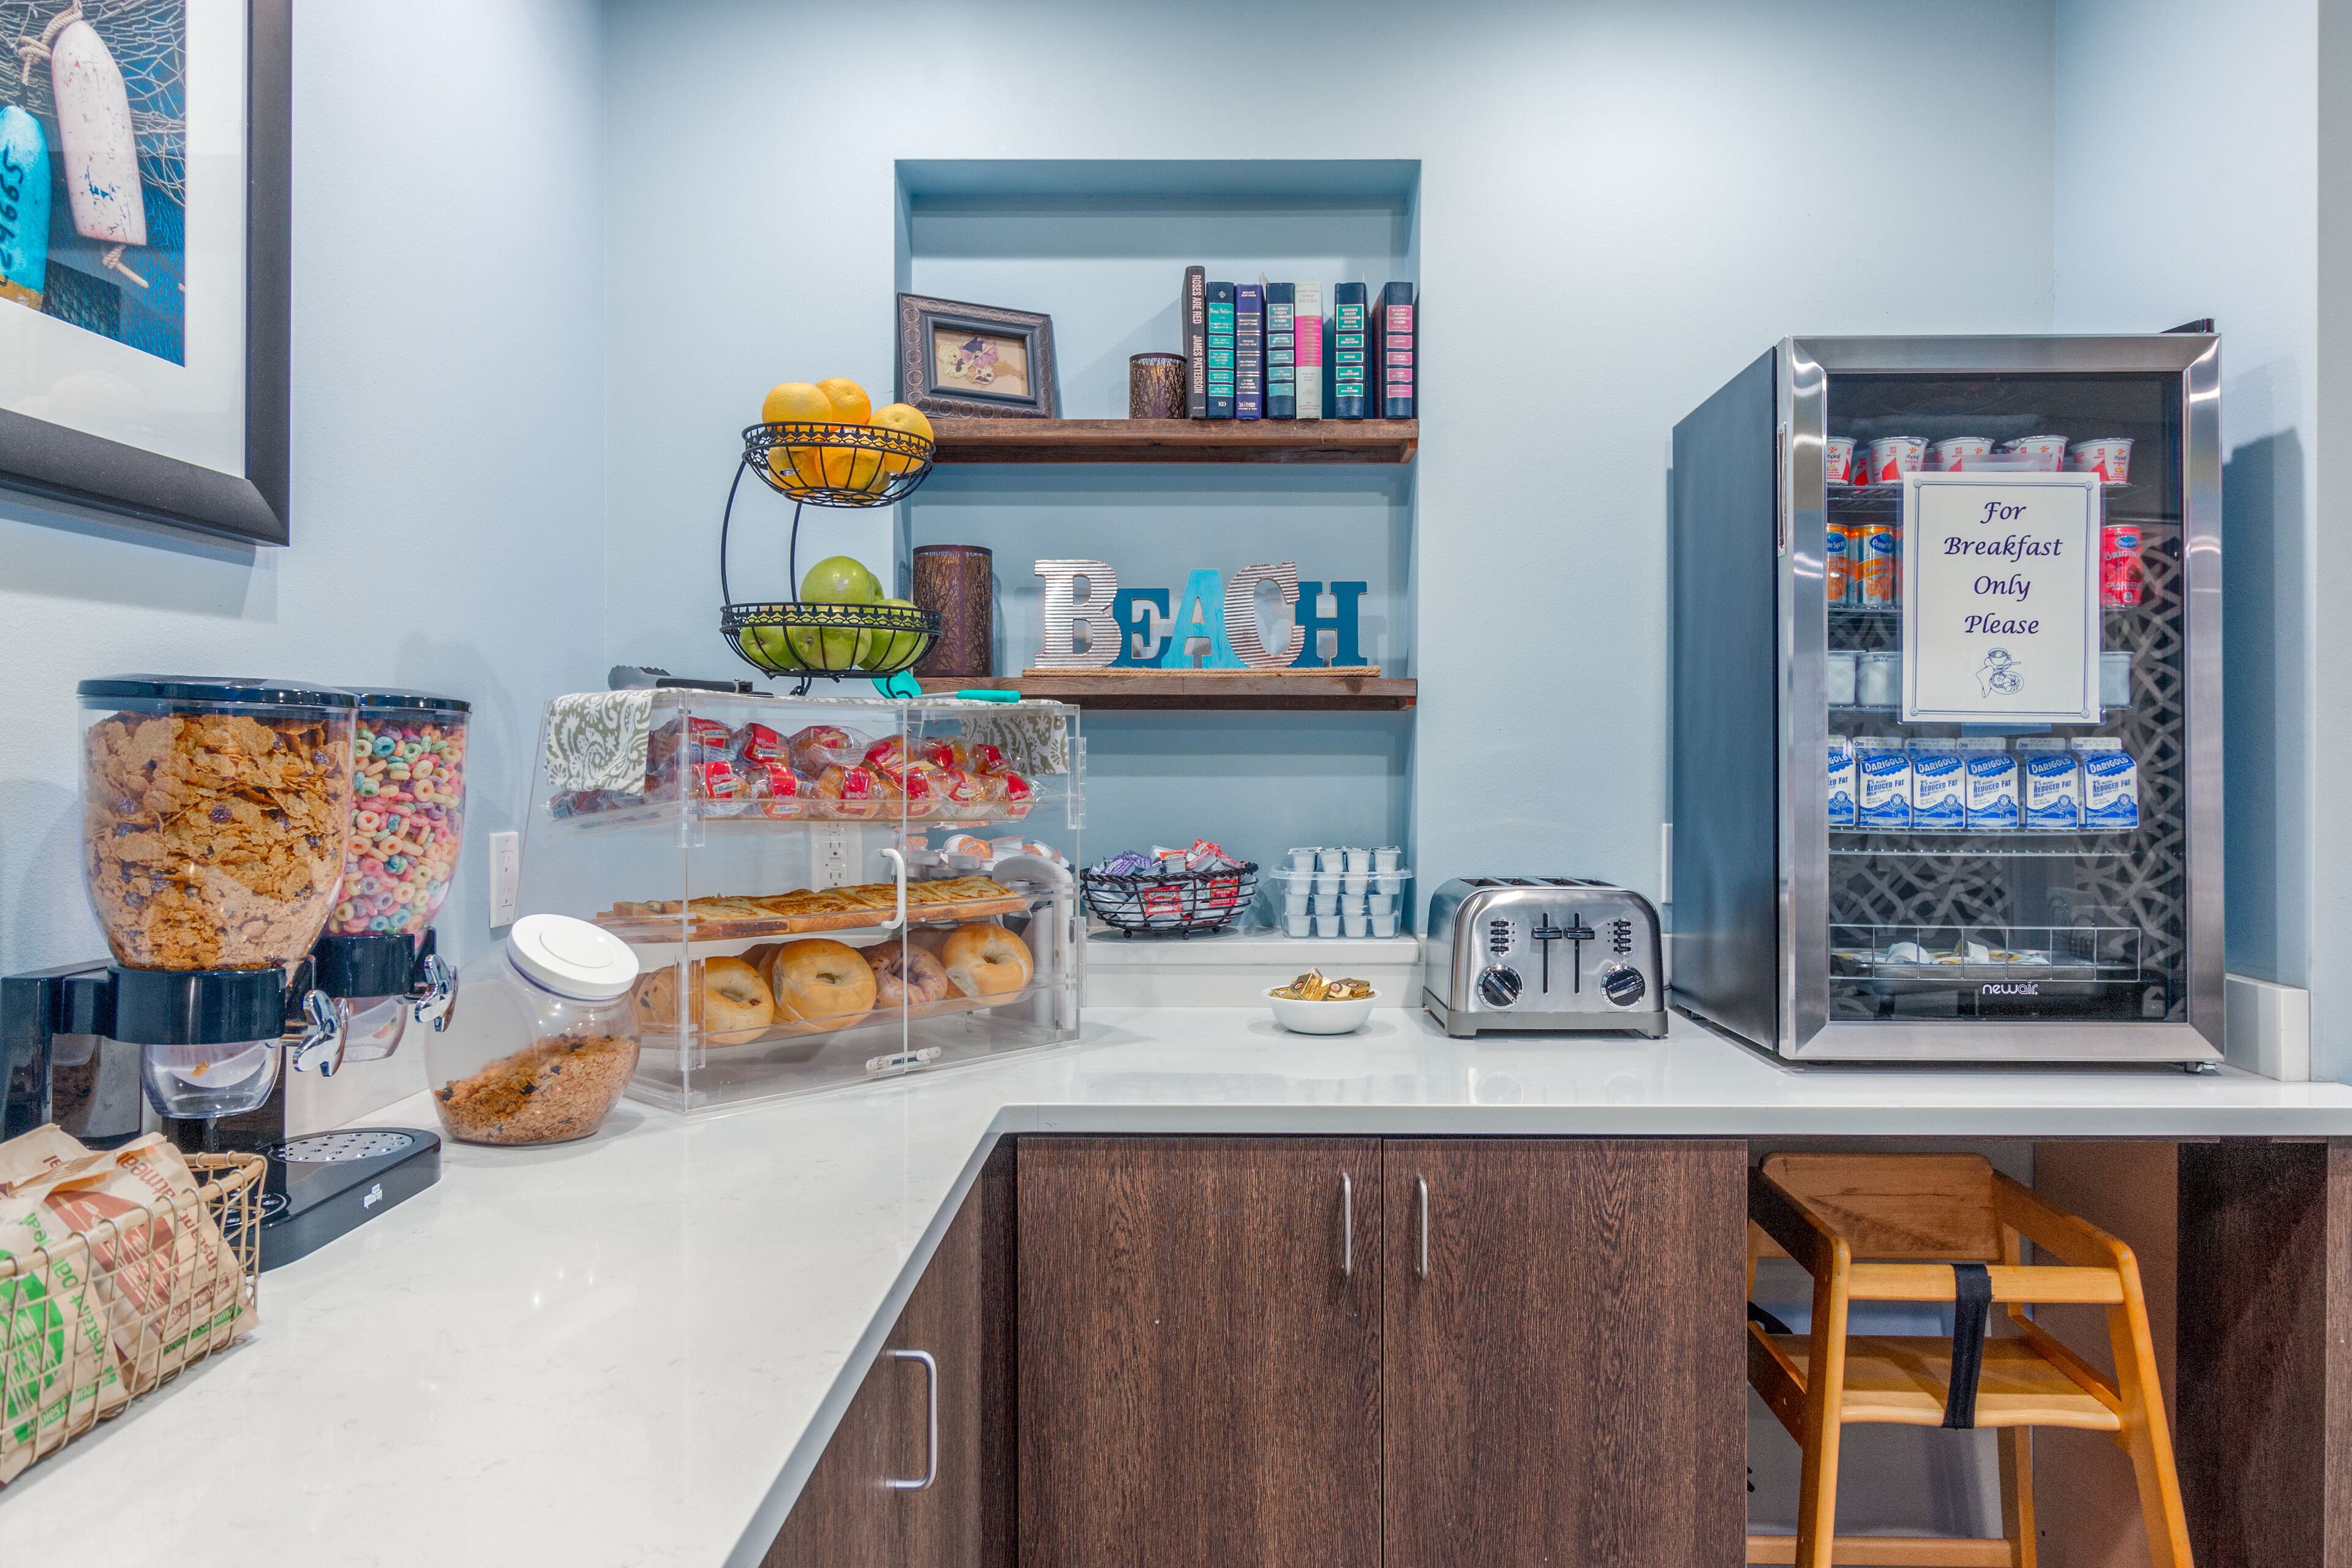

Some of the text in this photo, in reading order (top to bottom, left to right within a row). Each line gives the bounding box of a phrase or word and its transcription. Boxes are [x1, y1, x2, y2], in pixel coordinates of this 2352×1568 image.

[1192, 275, 1203, 393] ROSES ARE RED JAMES PATTERSON
[1980, 502, 2027, 524] For
[1833, 541, 1845, 549] Spray
[1872, 539, 1886, 549] Ocean
[1944, 535, 2064, 562] Breakfast
[1973, 574, 2031, 601] Only
[1035, 559, 1368, 669] BEACH
[1964, 612, 2039, 634] Please
[1865, 757, 1904, 772] DARIGOLD
[1918, 758, 1957, 773] DARIGOLD
[1971, 758, 2010, 774] DARIGOLD
[2032, 758, 2071, 774] DARIGOLD
[2090, 757, 2129, 773] DARIGOLD
[1866, 782, 1892, 793] REDUCED
[1920, 782, 1946, 793] REDUCED
[1973, 782, 1999, 794] REDUCED
[2034, 783, 2059, 794] REDUCED
[2093, 782, 2119, 793] REDUCED
[1983, 980, 2038, 995] newair
[116, 1153, 177, 1199] atmeal
